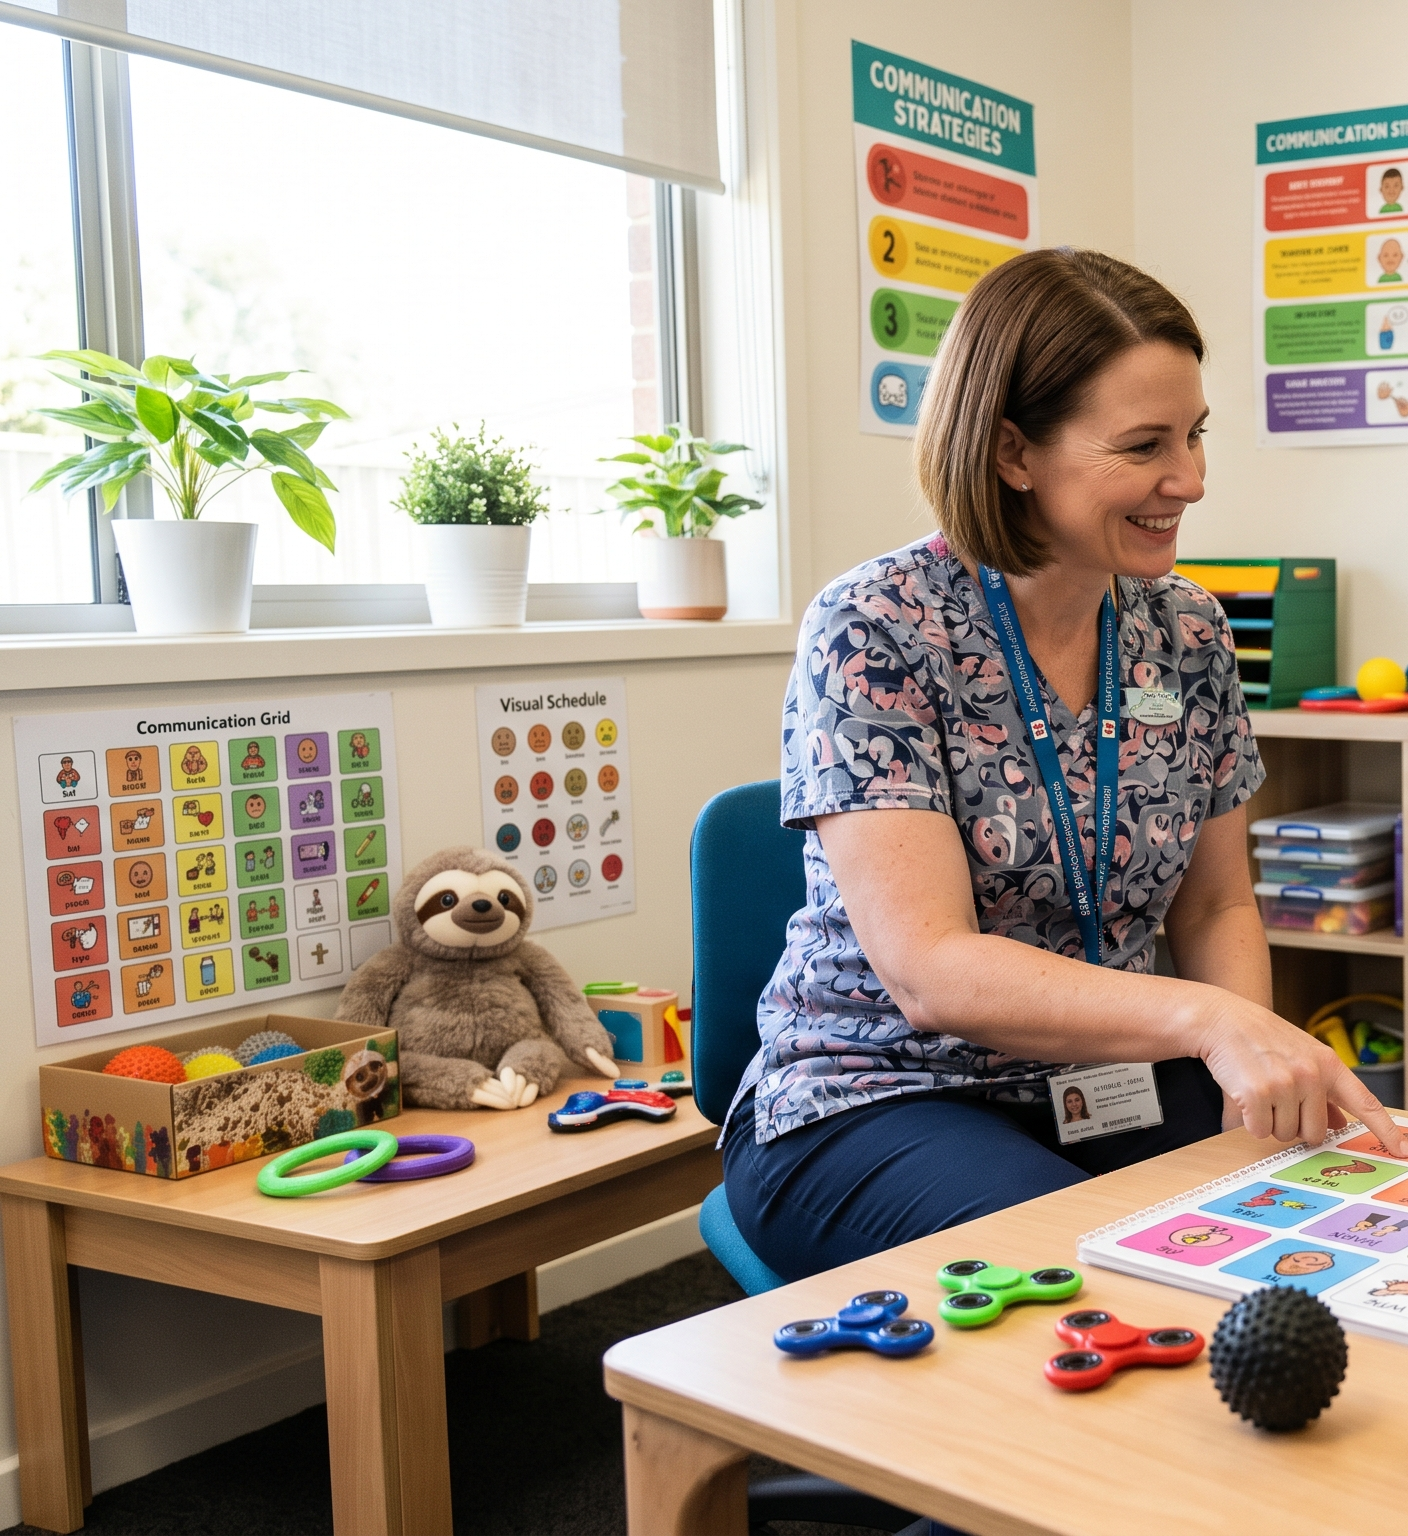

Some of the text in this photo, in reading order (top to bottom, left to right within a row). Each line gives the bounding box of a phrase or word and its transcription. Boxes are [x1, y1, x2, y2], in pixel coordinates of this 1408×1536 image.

[869, 60, 1022, 135] COMMUNICATION
[893, 98, 1003, 157] STRATEGIES
[1265, 123, 1388, 153] COMMUNICATION
[883, 229, 895, 264] 2
[884, 302, 898, 337] 3
[500, 691, 607, 713] Visual Schedule
[136, 710, 291, 735] Communication Grid
